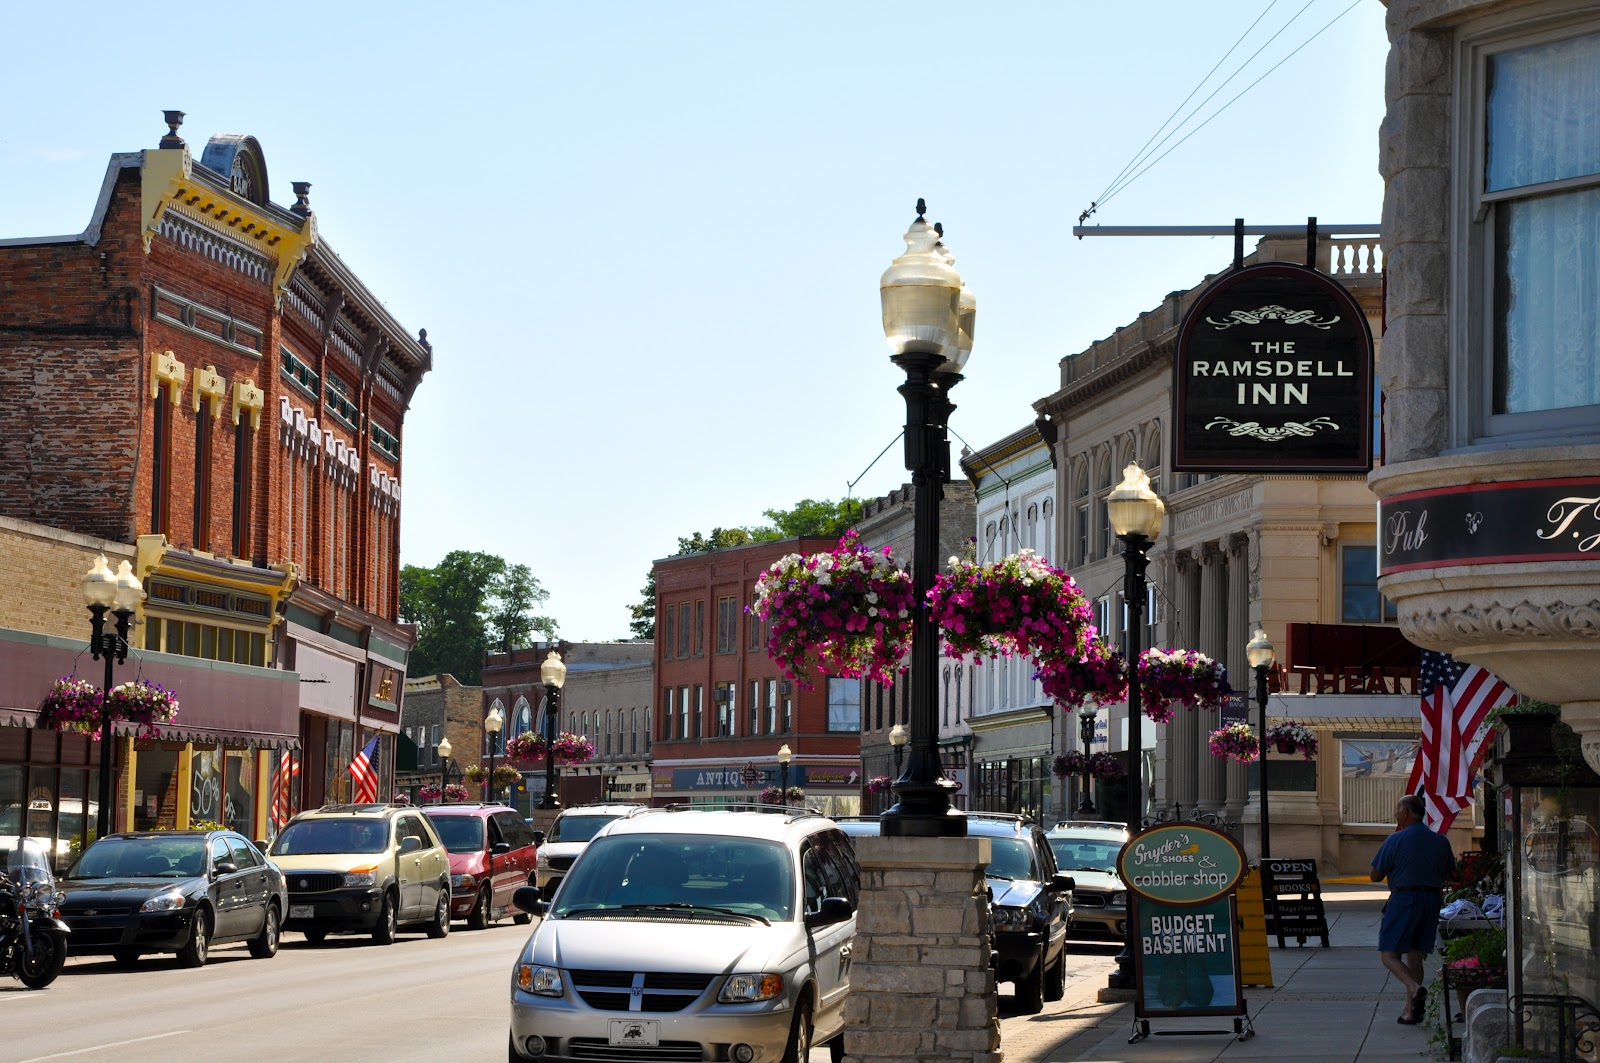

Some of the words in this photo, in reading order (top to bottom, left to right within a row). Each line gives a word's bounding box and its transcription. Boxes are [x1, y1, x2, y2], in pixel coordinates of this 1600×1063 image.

[1251, 342, 1295, 354] THE
[1192, 361, 1353, 376] RAMSDELL
[1237, 383, 1308, 405] INN
[1200, 502, 1219, 523] COUNTY
[1384, 510, 1428, 555] Pub
[696, 771, 766, 786] ANTIQS
[191, 770, 220, 815] 50%
[224, 792, 236, 823] OFF
[1134, 833, 1190, 865] Snyder's
[1162, 855, 1195, 863] SHOES
[1197, 855, 1217, 868] &
[1270, 862, 1313, 872] OPEN
[1133, 870, 1190, 887] cobbler
[1193, 869, 1228, 889] shop
[1278, 884, 1311, 892] BOOKS
[1278, 905, 1315, 913] Magazines
[1151, 914, 1215, 935] BUDGET
[1142, 933, 1227, 955] BASEMENT
